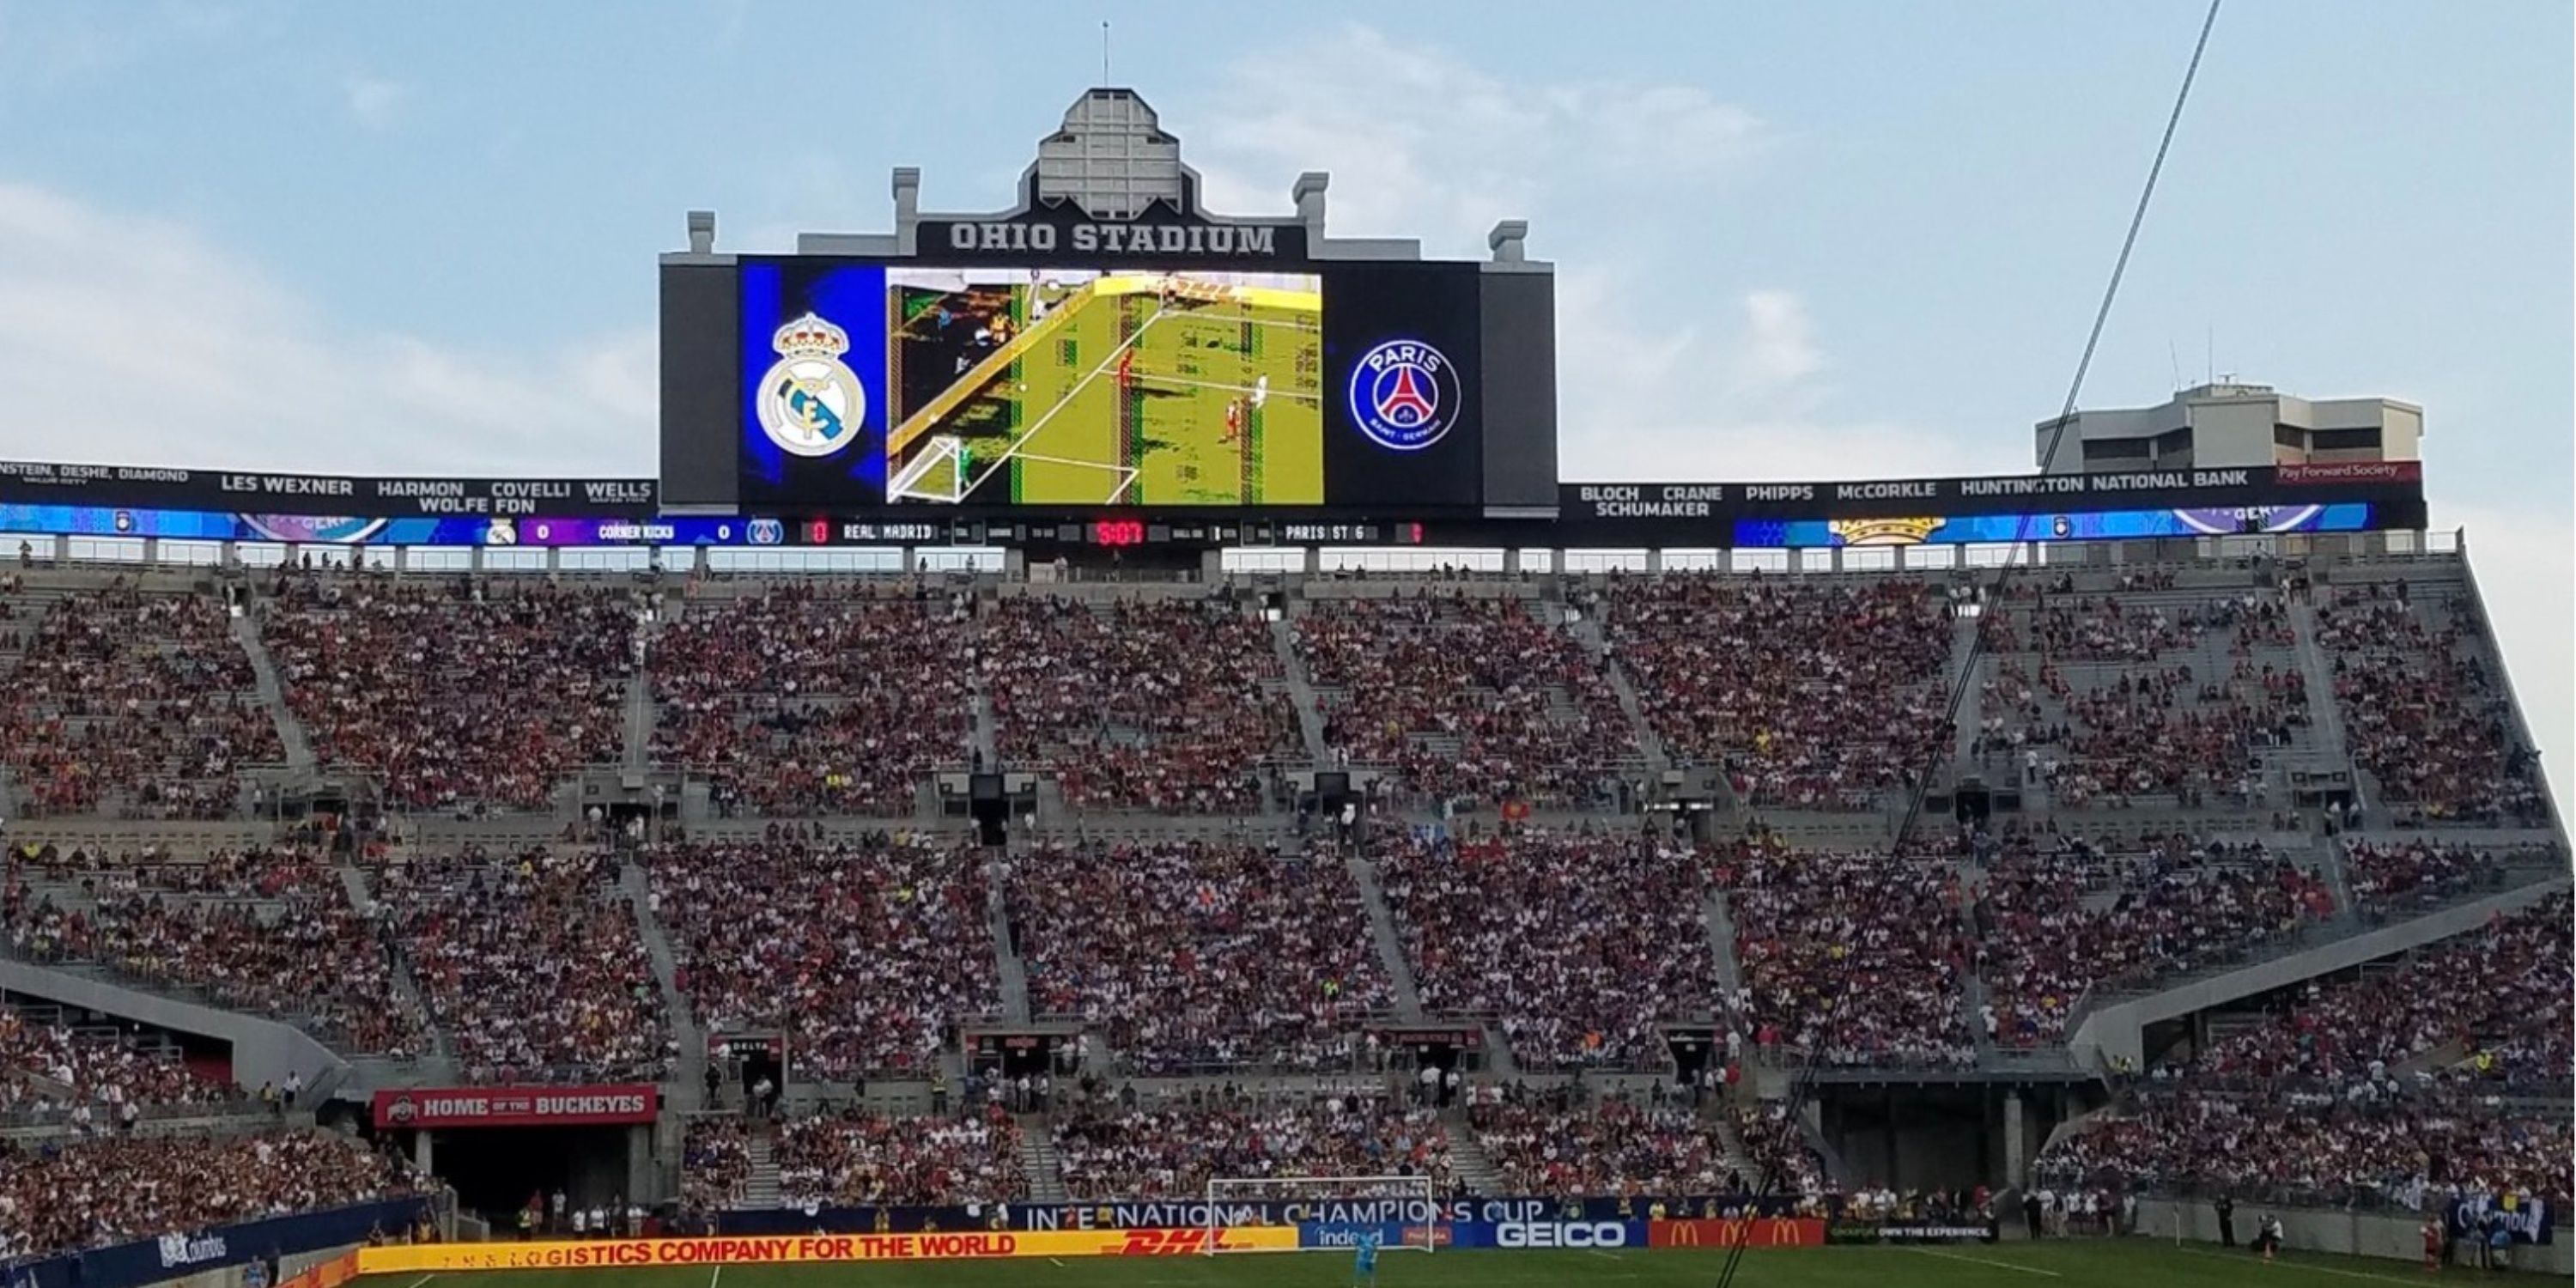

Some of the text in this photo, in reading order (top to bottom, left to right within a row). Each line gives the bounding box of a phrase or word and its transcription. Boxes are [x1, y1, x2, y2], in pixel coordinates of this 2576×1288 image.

[951, 222, 1275, 254] OHIO STADIUM
[1369, 346, 1441, 372] PARIS
[118, 468, 188, 483] DIAMOND
[2279, 464, 2397, 480] Pay Forward Society
[222, 476, 353, 495] LES WEXNER
[378, 482, 464, 497] HARMON
[491, 483, 570, 497] COVELLI
[585, 483, 651, 498] WELLS
[1961, 471, 2248, 496] HUNTINGTON NATIONAL BANK
[1581, 487, 1638, 501] BLOCH
[1663, 487, 1722, 501] CRANE
[1746, 486, 1814, 501] PHIPPS
[1838, 483, 1937, 500] McCORKLE
[419, 497, 535, 513] WOLFE FDN
[1596, 502, 1710, 517] SCHUMAKER
[536, 525, 550, 540] 0
[598, 525, 674, 540] CORNER KICKS
[718, 526, 730, 539] 0
[844, 525, 932, 539] REAL MADRID
[1096, 521, 1143, 544] 5:07
[1286, 525, 1325, 540] PARIS
[1333, 525, 1347, 540] ST
[733, 1042, 769, 1051] DELTA
[424, 1096, 645, 1116] HOME OF THE BUCKEYES
[1484, 1200, 1544, 1223] CUP
[1318, 1228, 1383, 1245] inded
[1497, 1223, 1625, 1248] GEICO
[1879, 1227, 1902, 1236] OWN
[1905, 1227, 1924, 1236] THE
[659, 1240, 790, 1263] COMPANY
[799, 1236, 854, 1259] FOR
[860, 1236, 914, 1258] THE
[920, 1235, 1017, 1256] WORLD
[1122, 1230, 1233, 1255] DHL
